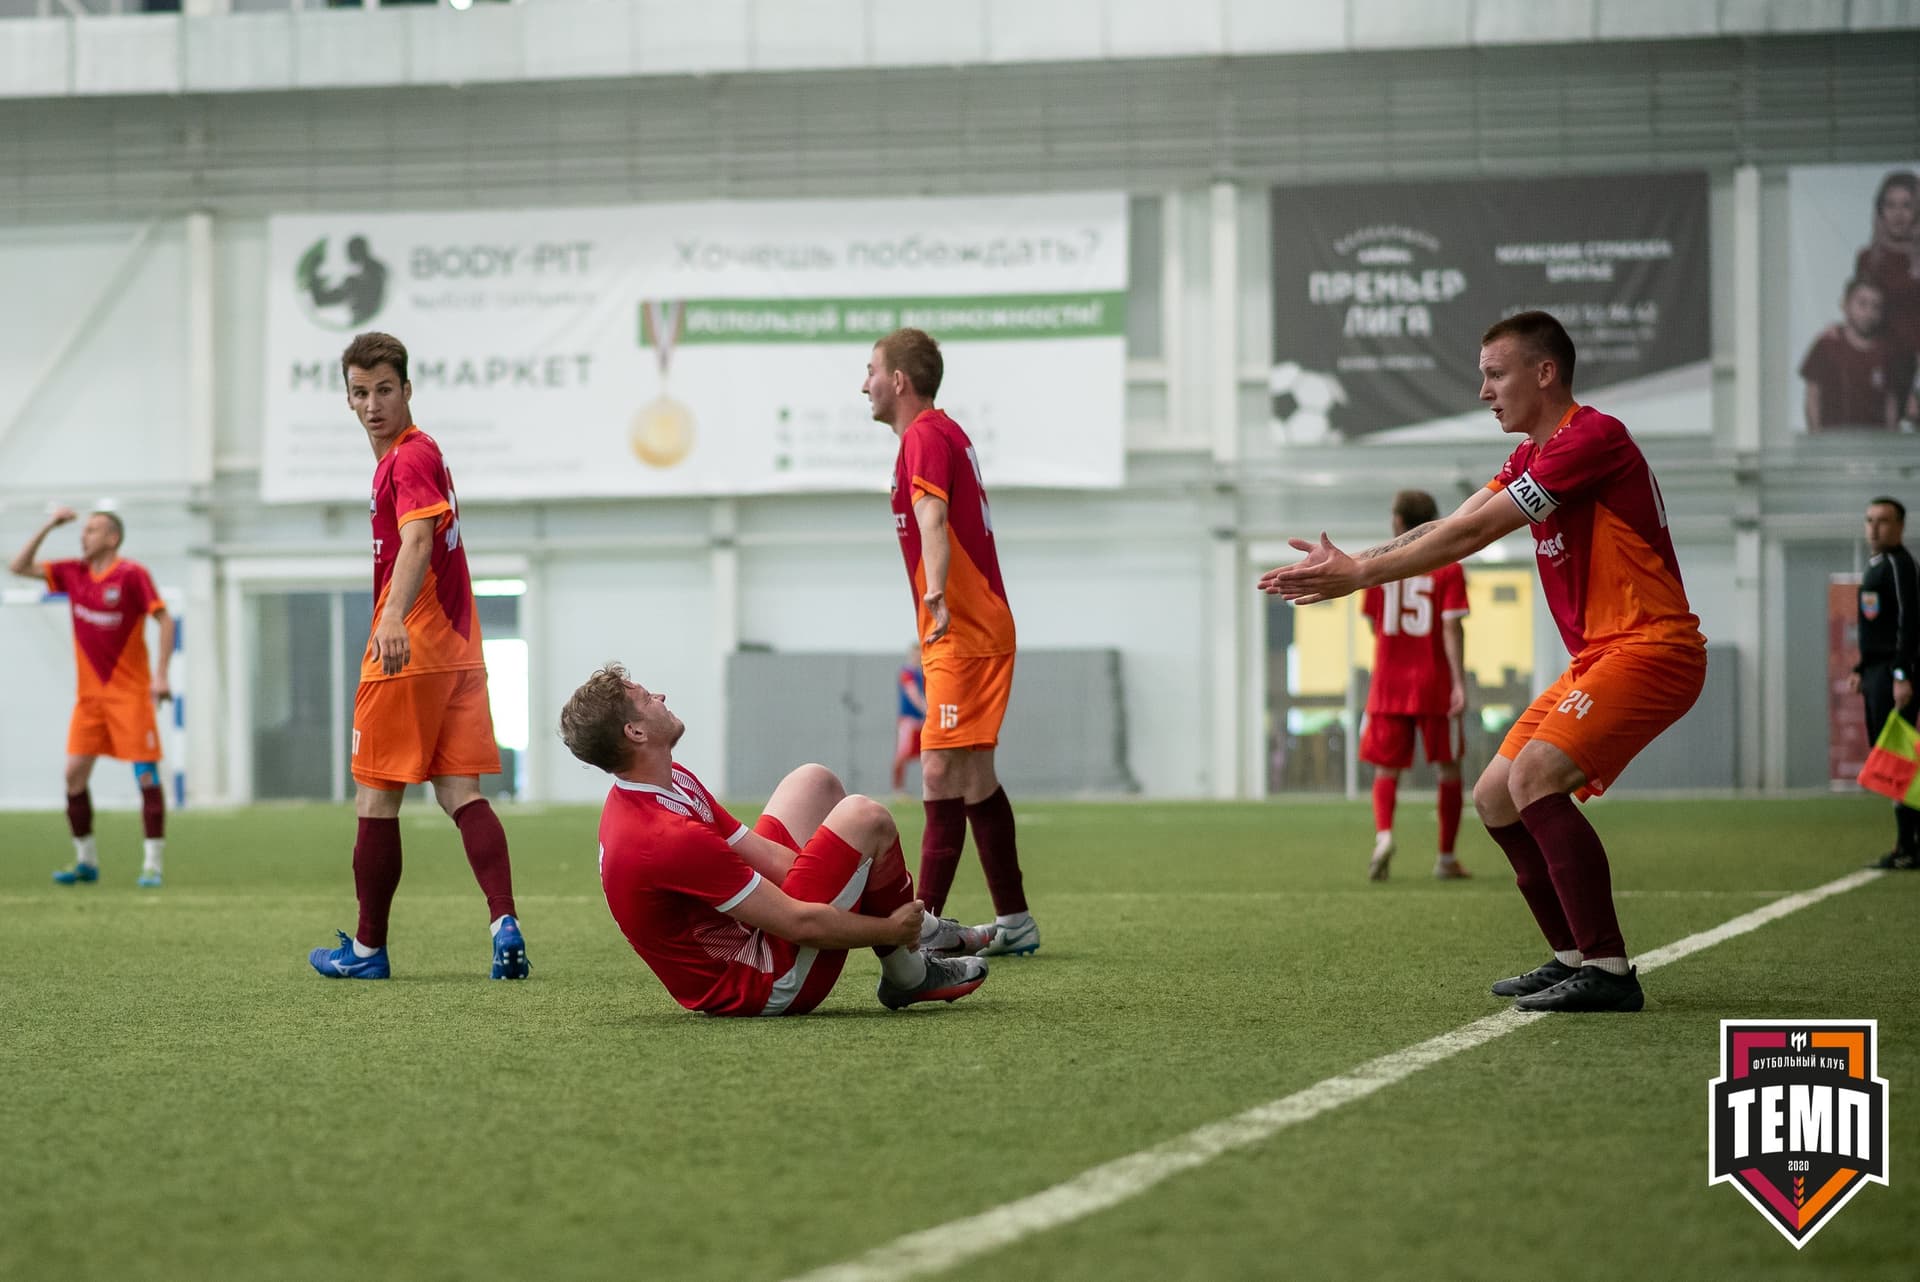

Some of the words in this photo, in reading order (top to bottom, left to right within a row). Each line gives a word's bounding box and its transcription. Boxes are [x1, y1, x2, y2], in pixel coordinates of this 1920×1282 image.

[409, 241, 594, 280] BODY-PIT
[1308, 268, 1467, 304] ПРЕМЬЕР
[1343, 305, 1432, 338] ЛИГА
[1382, 575, 1434, 637] 15
[938, 703, 958, 729] 15
[1557, 690, 1594, 720] 24
